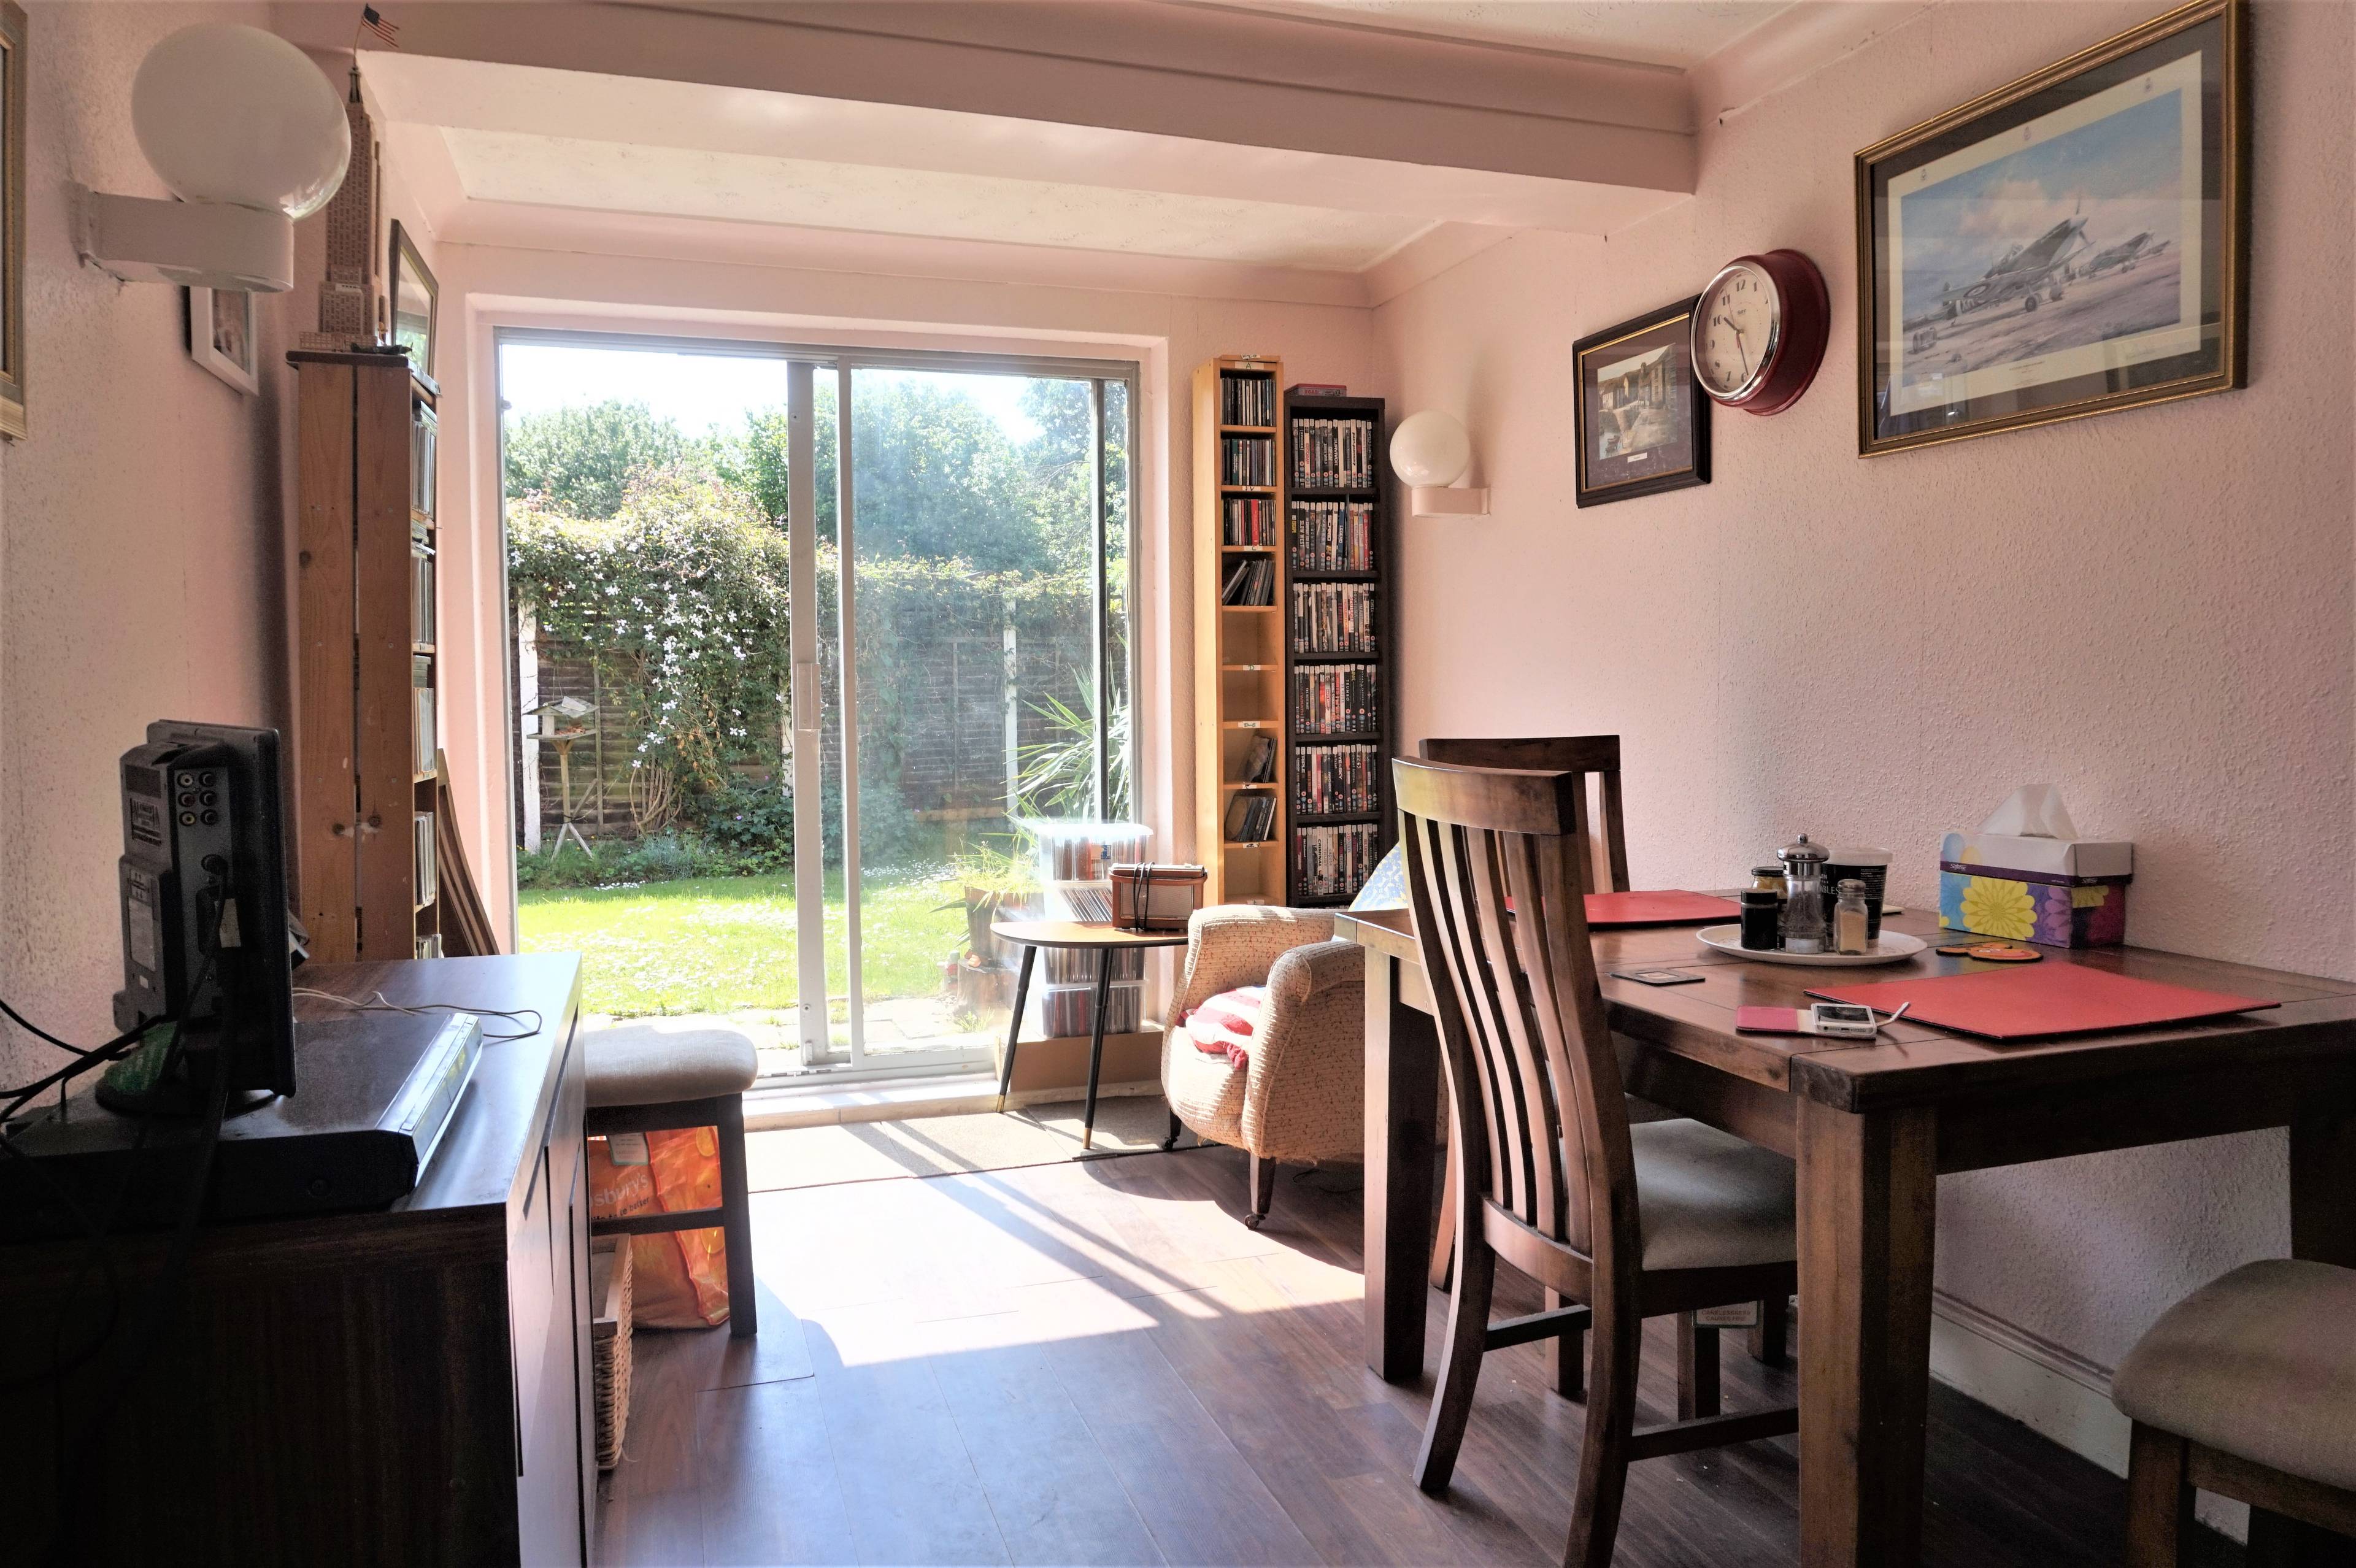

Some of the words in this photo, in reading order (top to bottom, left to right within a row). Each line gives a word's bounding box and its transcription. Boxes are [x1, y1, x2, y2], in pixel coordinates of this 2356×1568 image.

[1736, 279, 1746, 292] 12
[1754, 282, 1757, 292] 1
[1722, 294, 1731, 306] 11
[1713, 314, 1722, 326] 10
[1726, 371, 1731, 382] 7
